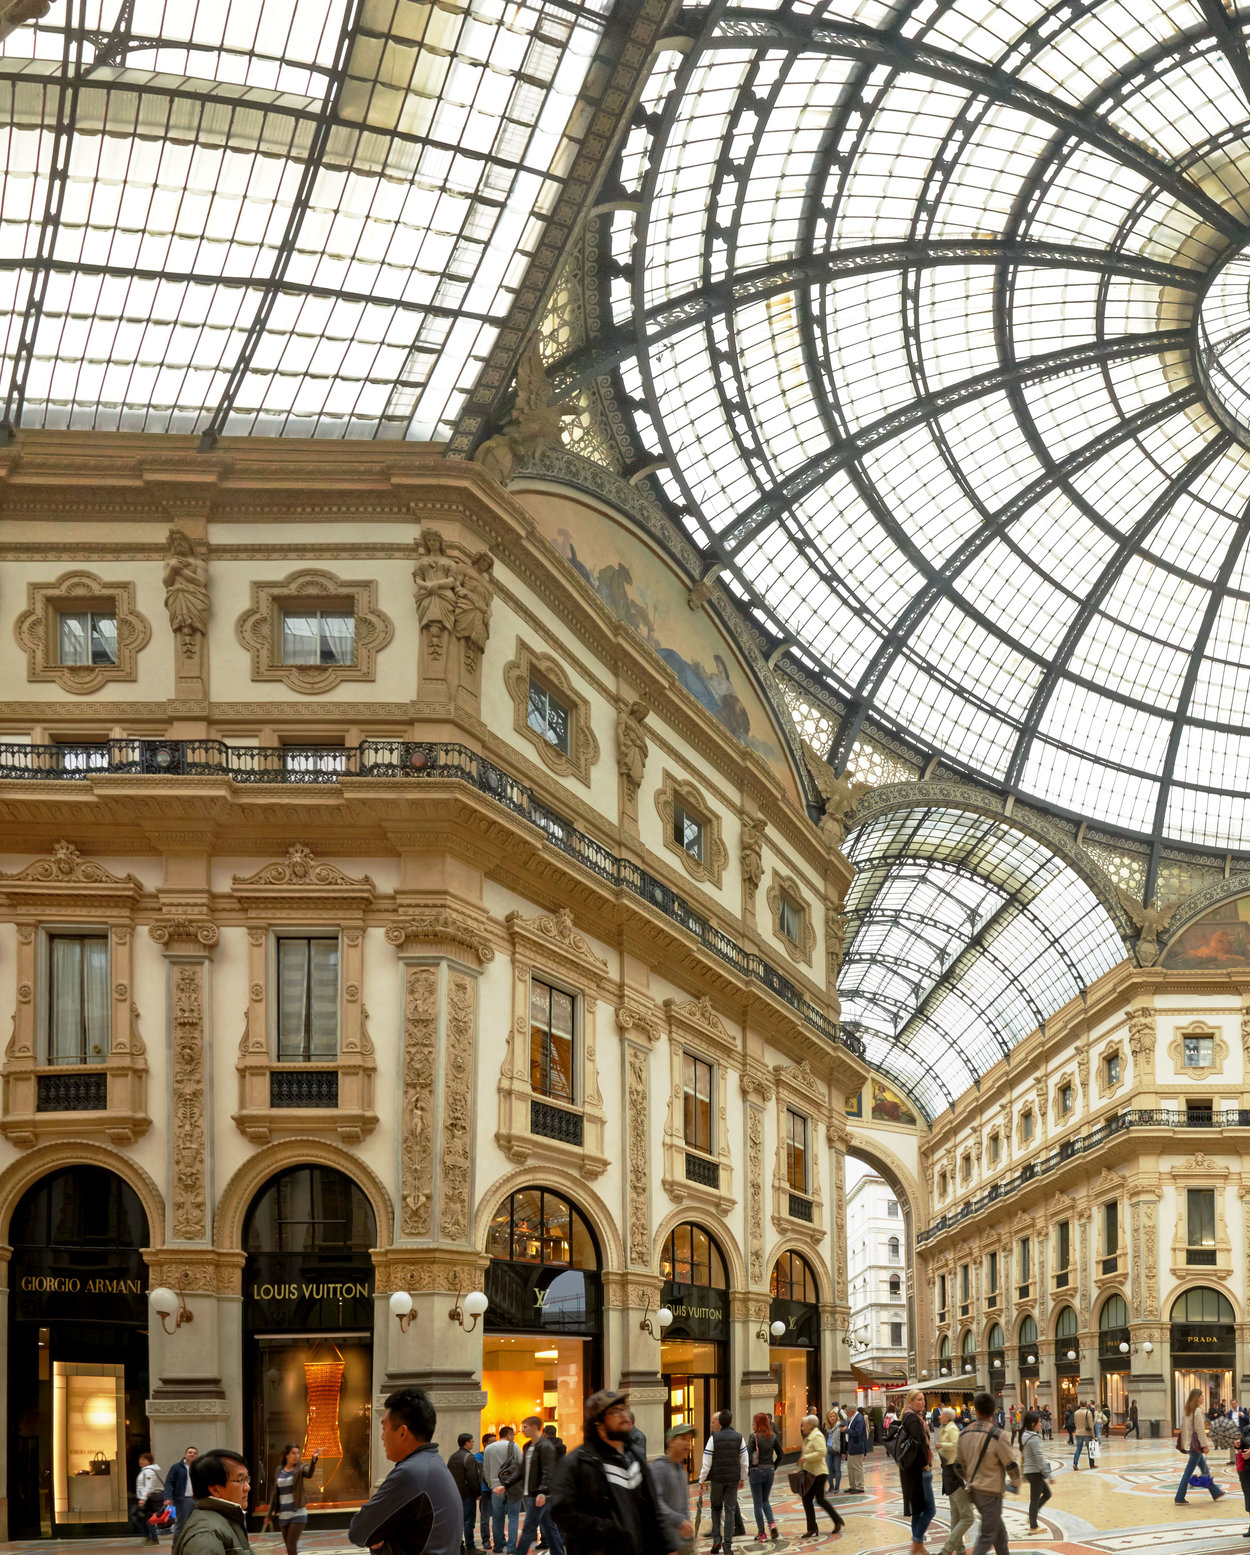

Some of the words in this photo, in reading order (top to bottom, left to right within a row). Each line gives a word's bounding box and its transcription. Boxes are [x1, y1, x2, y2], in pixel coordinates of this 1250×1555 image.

[21, 1276, 81, 1293] GIORGIO
[85, 1279, 141, 1294] ARMANI
[253, 1283, 298, 1300] LOUIS
[302, 1282, 369, 1299] VUITTON
[688, 1306, 722, 1320] VUITTON
